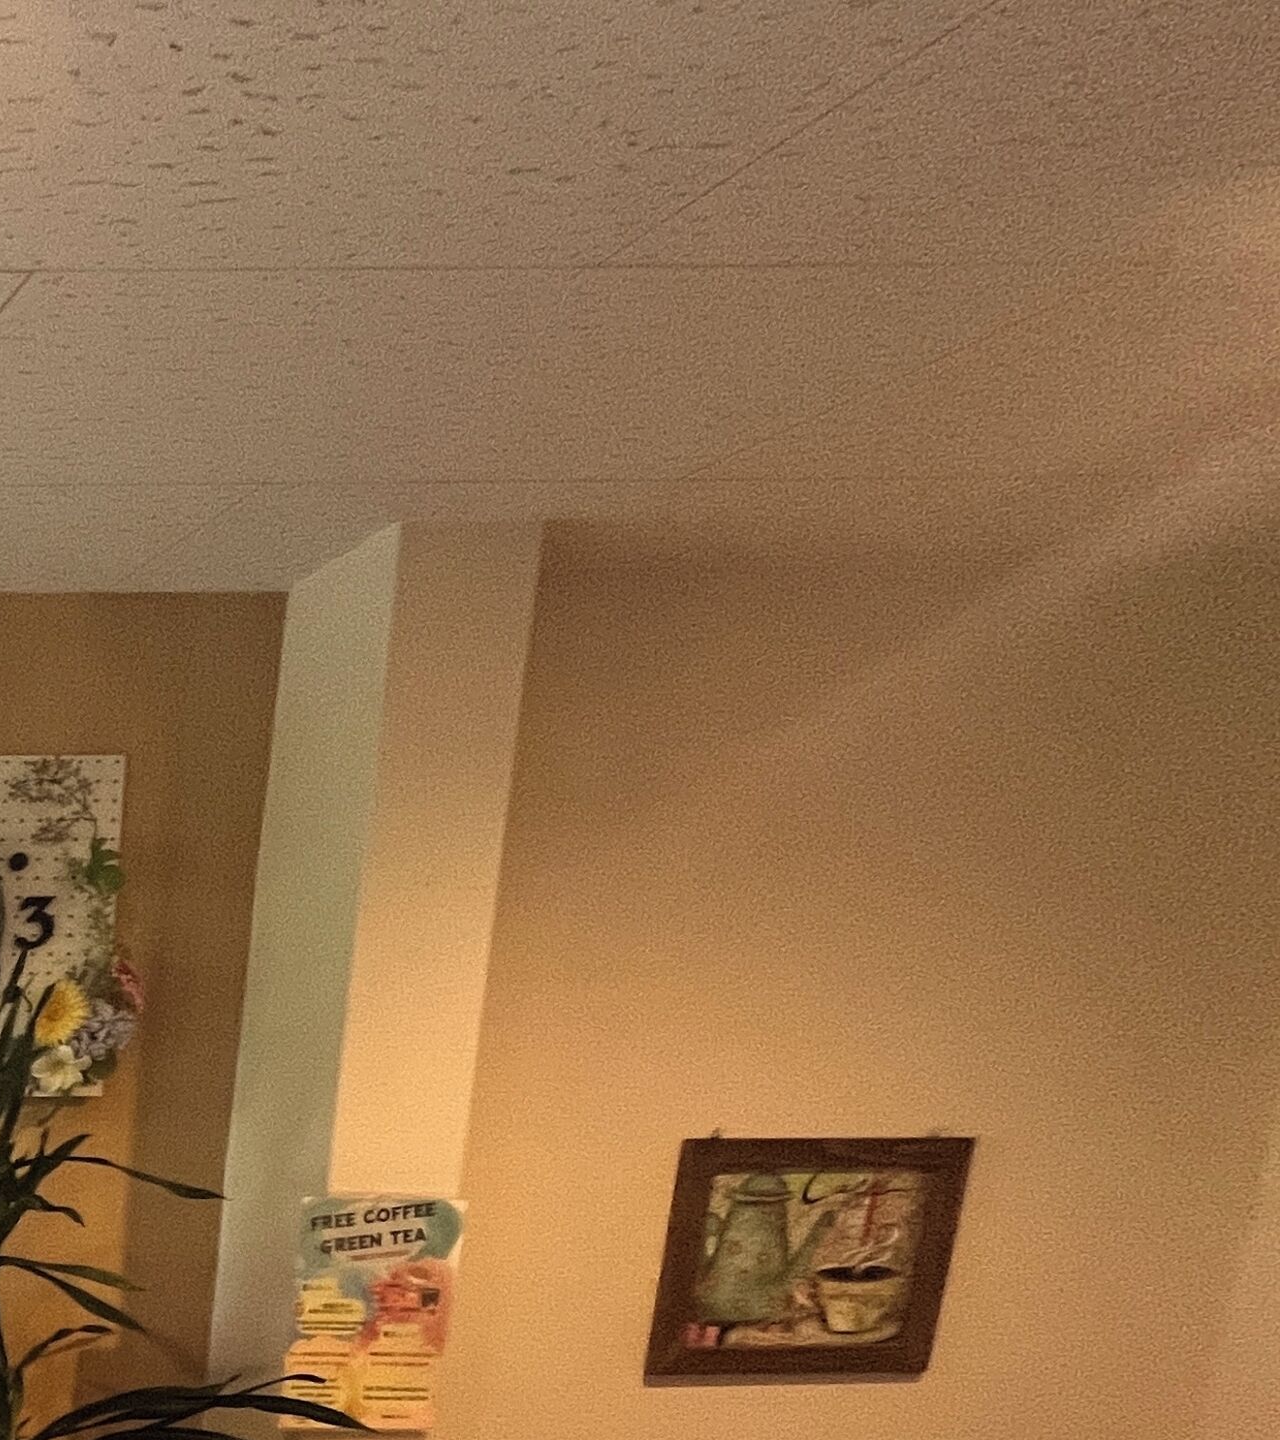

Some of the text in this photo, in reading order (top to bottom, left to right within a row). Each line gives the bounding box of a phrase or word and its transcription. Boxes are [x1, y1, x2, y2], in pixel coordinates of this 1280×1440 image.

[14, 896, 57, 951] 3
[311, 1201, 437, 1231] FREE COFFEE
[320, 1228, 427, 1254] GREEN TEA
